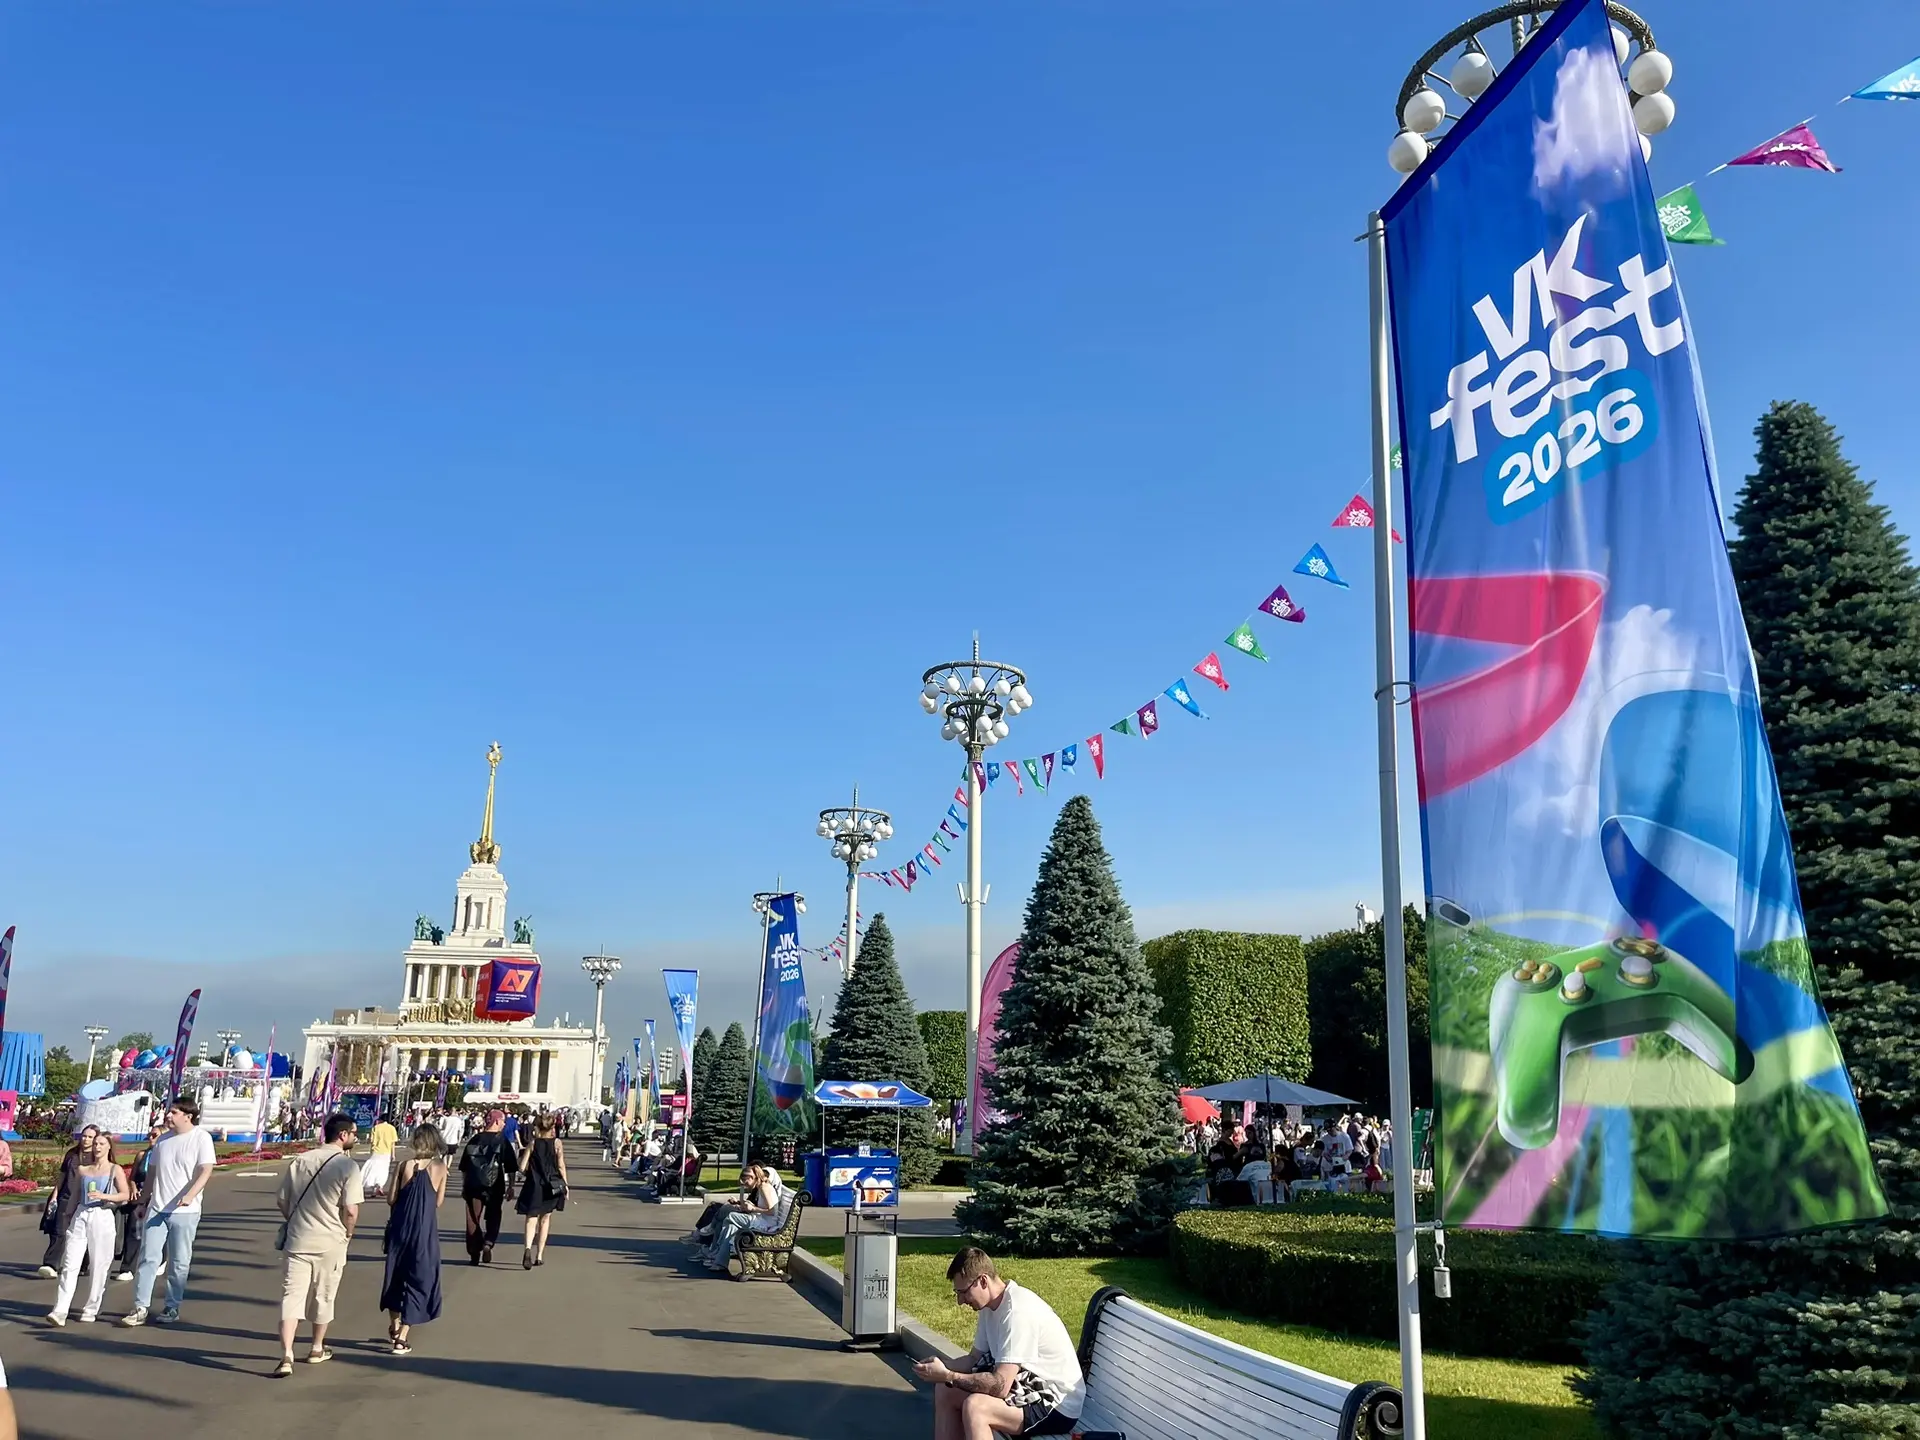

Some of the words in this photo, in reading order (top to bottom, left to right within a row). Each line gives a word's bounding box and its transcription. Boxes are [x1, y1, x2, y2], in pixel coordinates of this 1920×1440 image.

[1472, 212, 1614, 361] VK
[1430, 253, 1685, 464] fest
[1499, 388, 1644, 507] 2026
[780, 932, 797, 950] VK
[780, 968, 800, 982] 2026
